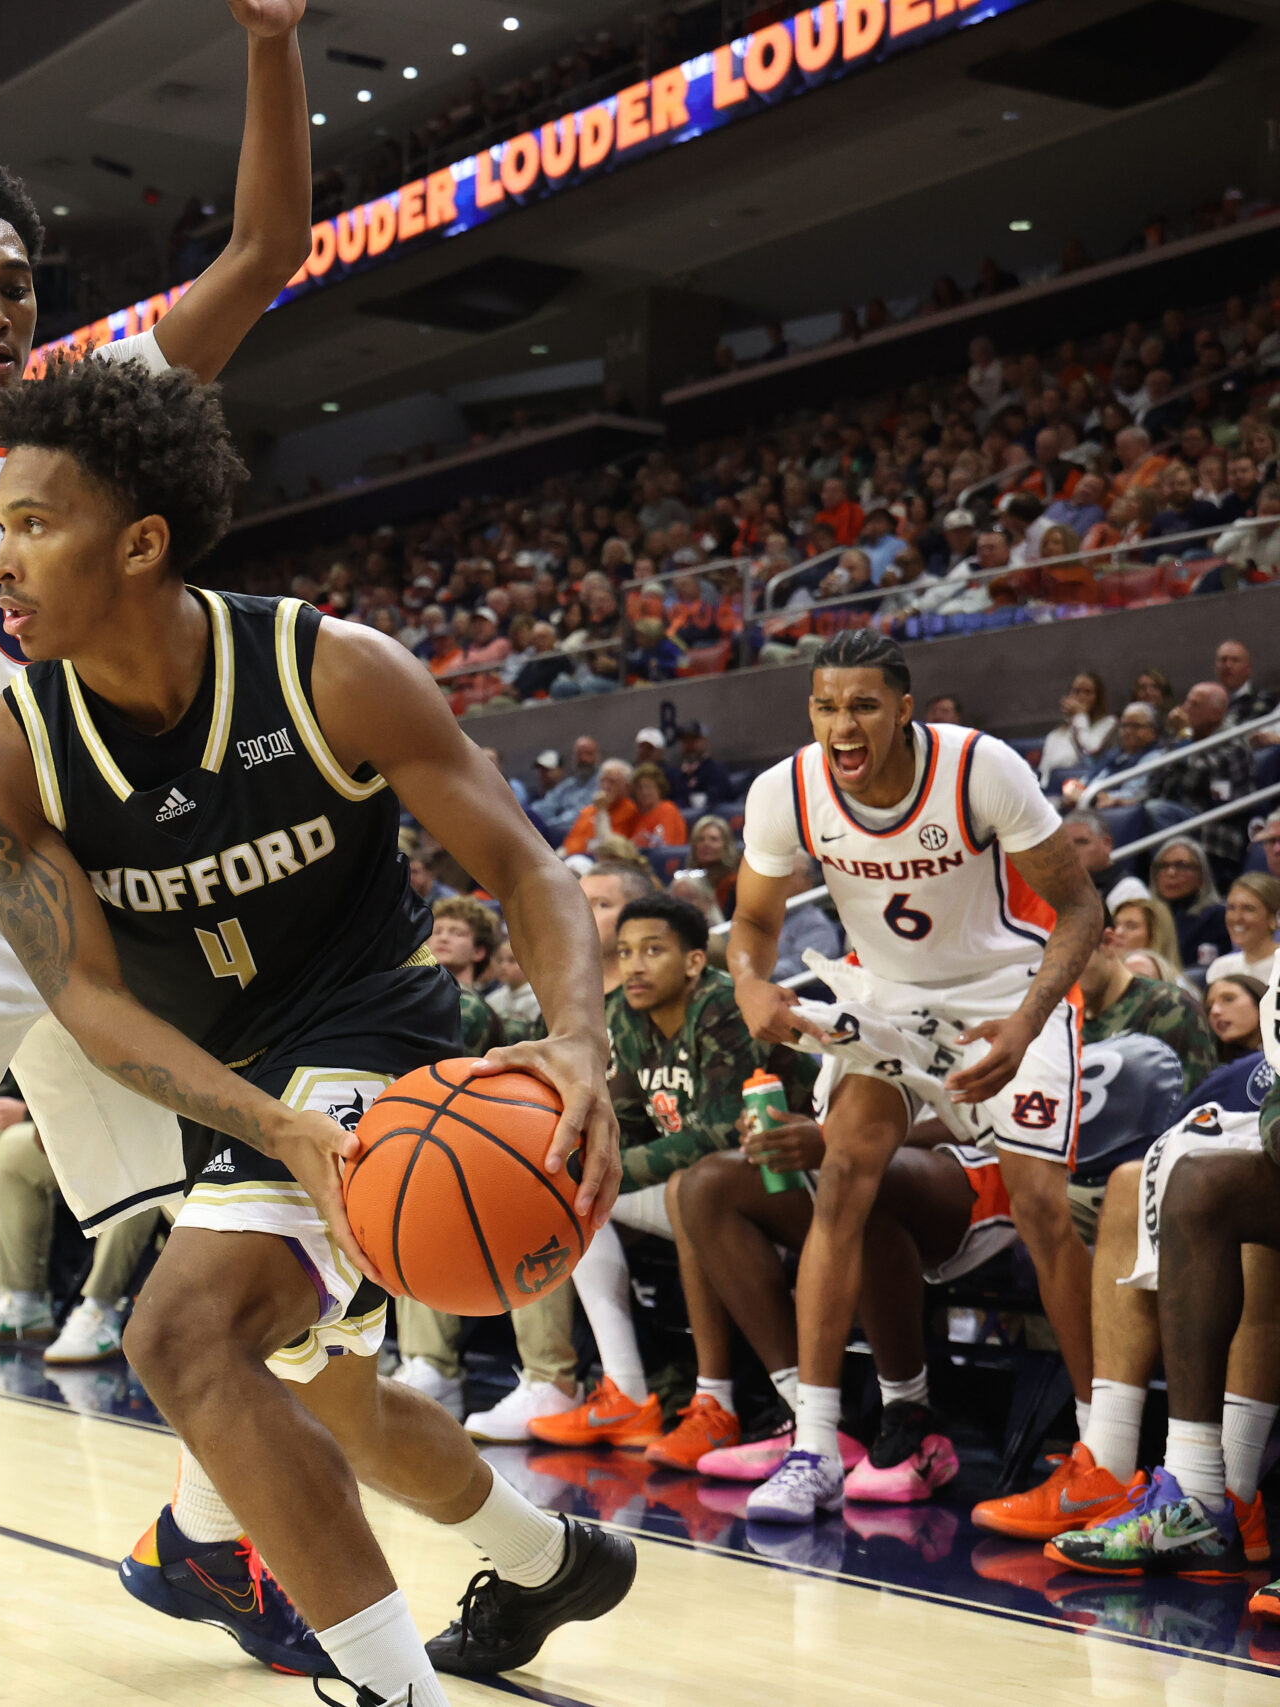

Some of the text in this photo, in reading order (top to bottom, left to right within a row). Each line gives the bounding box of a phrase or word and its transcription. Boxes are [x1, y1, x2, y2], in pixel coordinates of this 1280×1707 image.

[476, 66, 690, 209] LOUDER
[155, 799, 197, 823] adidas
[919, 824, 948, 851] SEC
[821, 849, 964, 881] AUBURN
[883, 893, 933, 942] 6
[193, 917, 258, 990] 4
